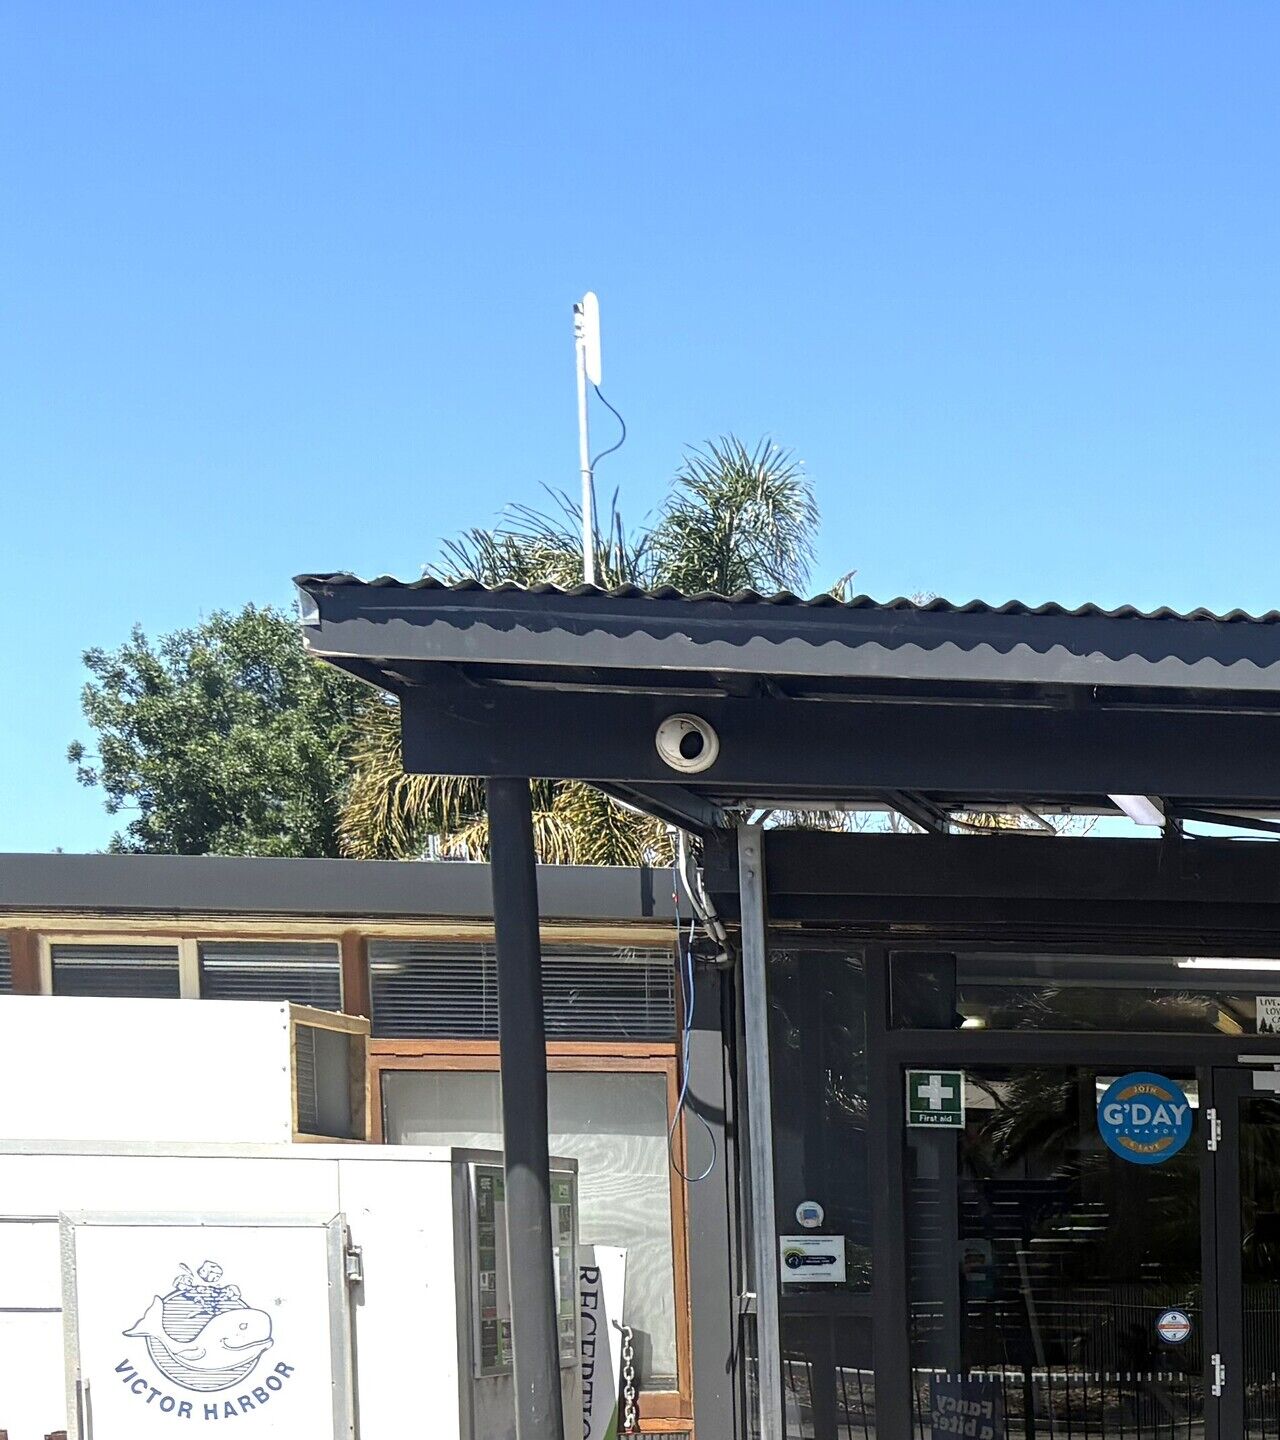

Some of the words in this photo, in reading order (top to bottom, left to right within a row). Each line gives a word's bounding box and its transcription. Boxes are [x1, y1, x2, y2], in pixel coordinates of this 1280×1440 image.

[1134, 1085, 1158, 1093] JOIN
[919, 1114, 937, 1122] First
[1103, 1103, 1188, 1126] G'DAY
[114, 1358, 193, 1419] VICTOR
[203, 1361, 295, 1420] HARBOR
